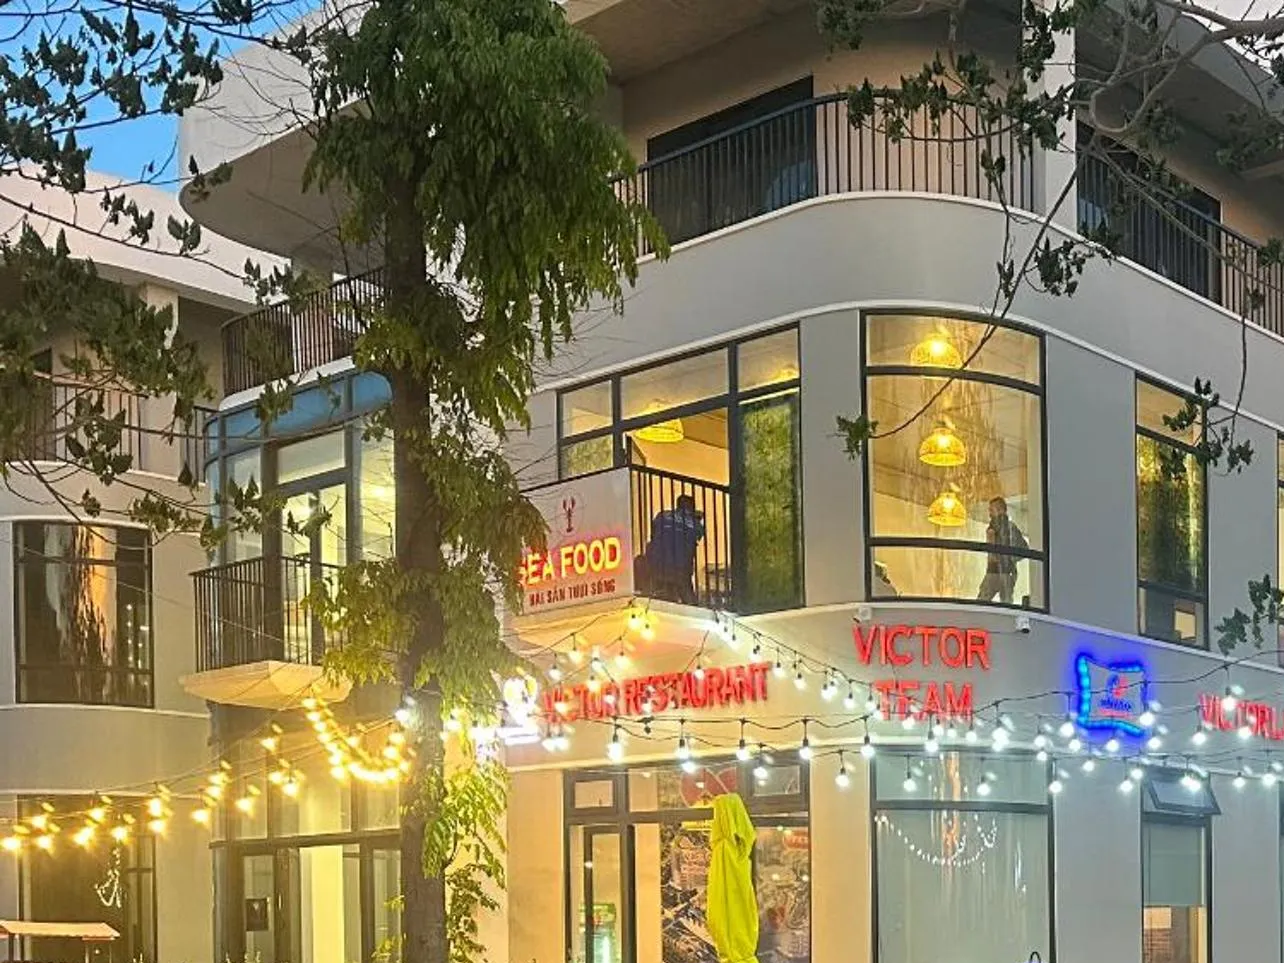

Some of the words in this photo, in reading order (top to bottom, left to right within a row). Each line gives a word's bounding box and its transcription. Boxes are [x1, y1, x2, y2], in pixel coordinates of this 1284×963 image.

[560, 536, 622, 578] FOOD
[852, 624, 990, 670] VICTOR
[621, 662, 773, 716] RESTAURANT
[874, 680, 973, 722] TEAM
